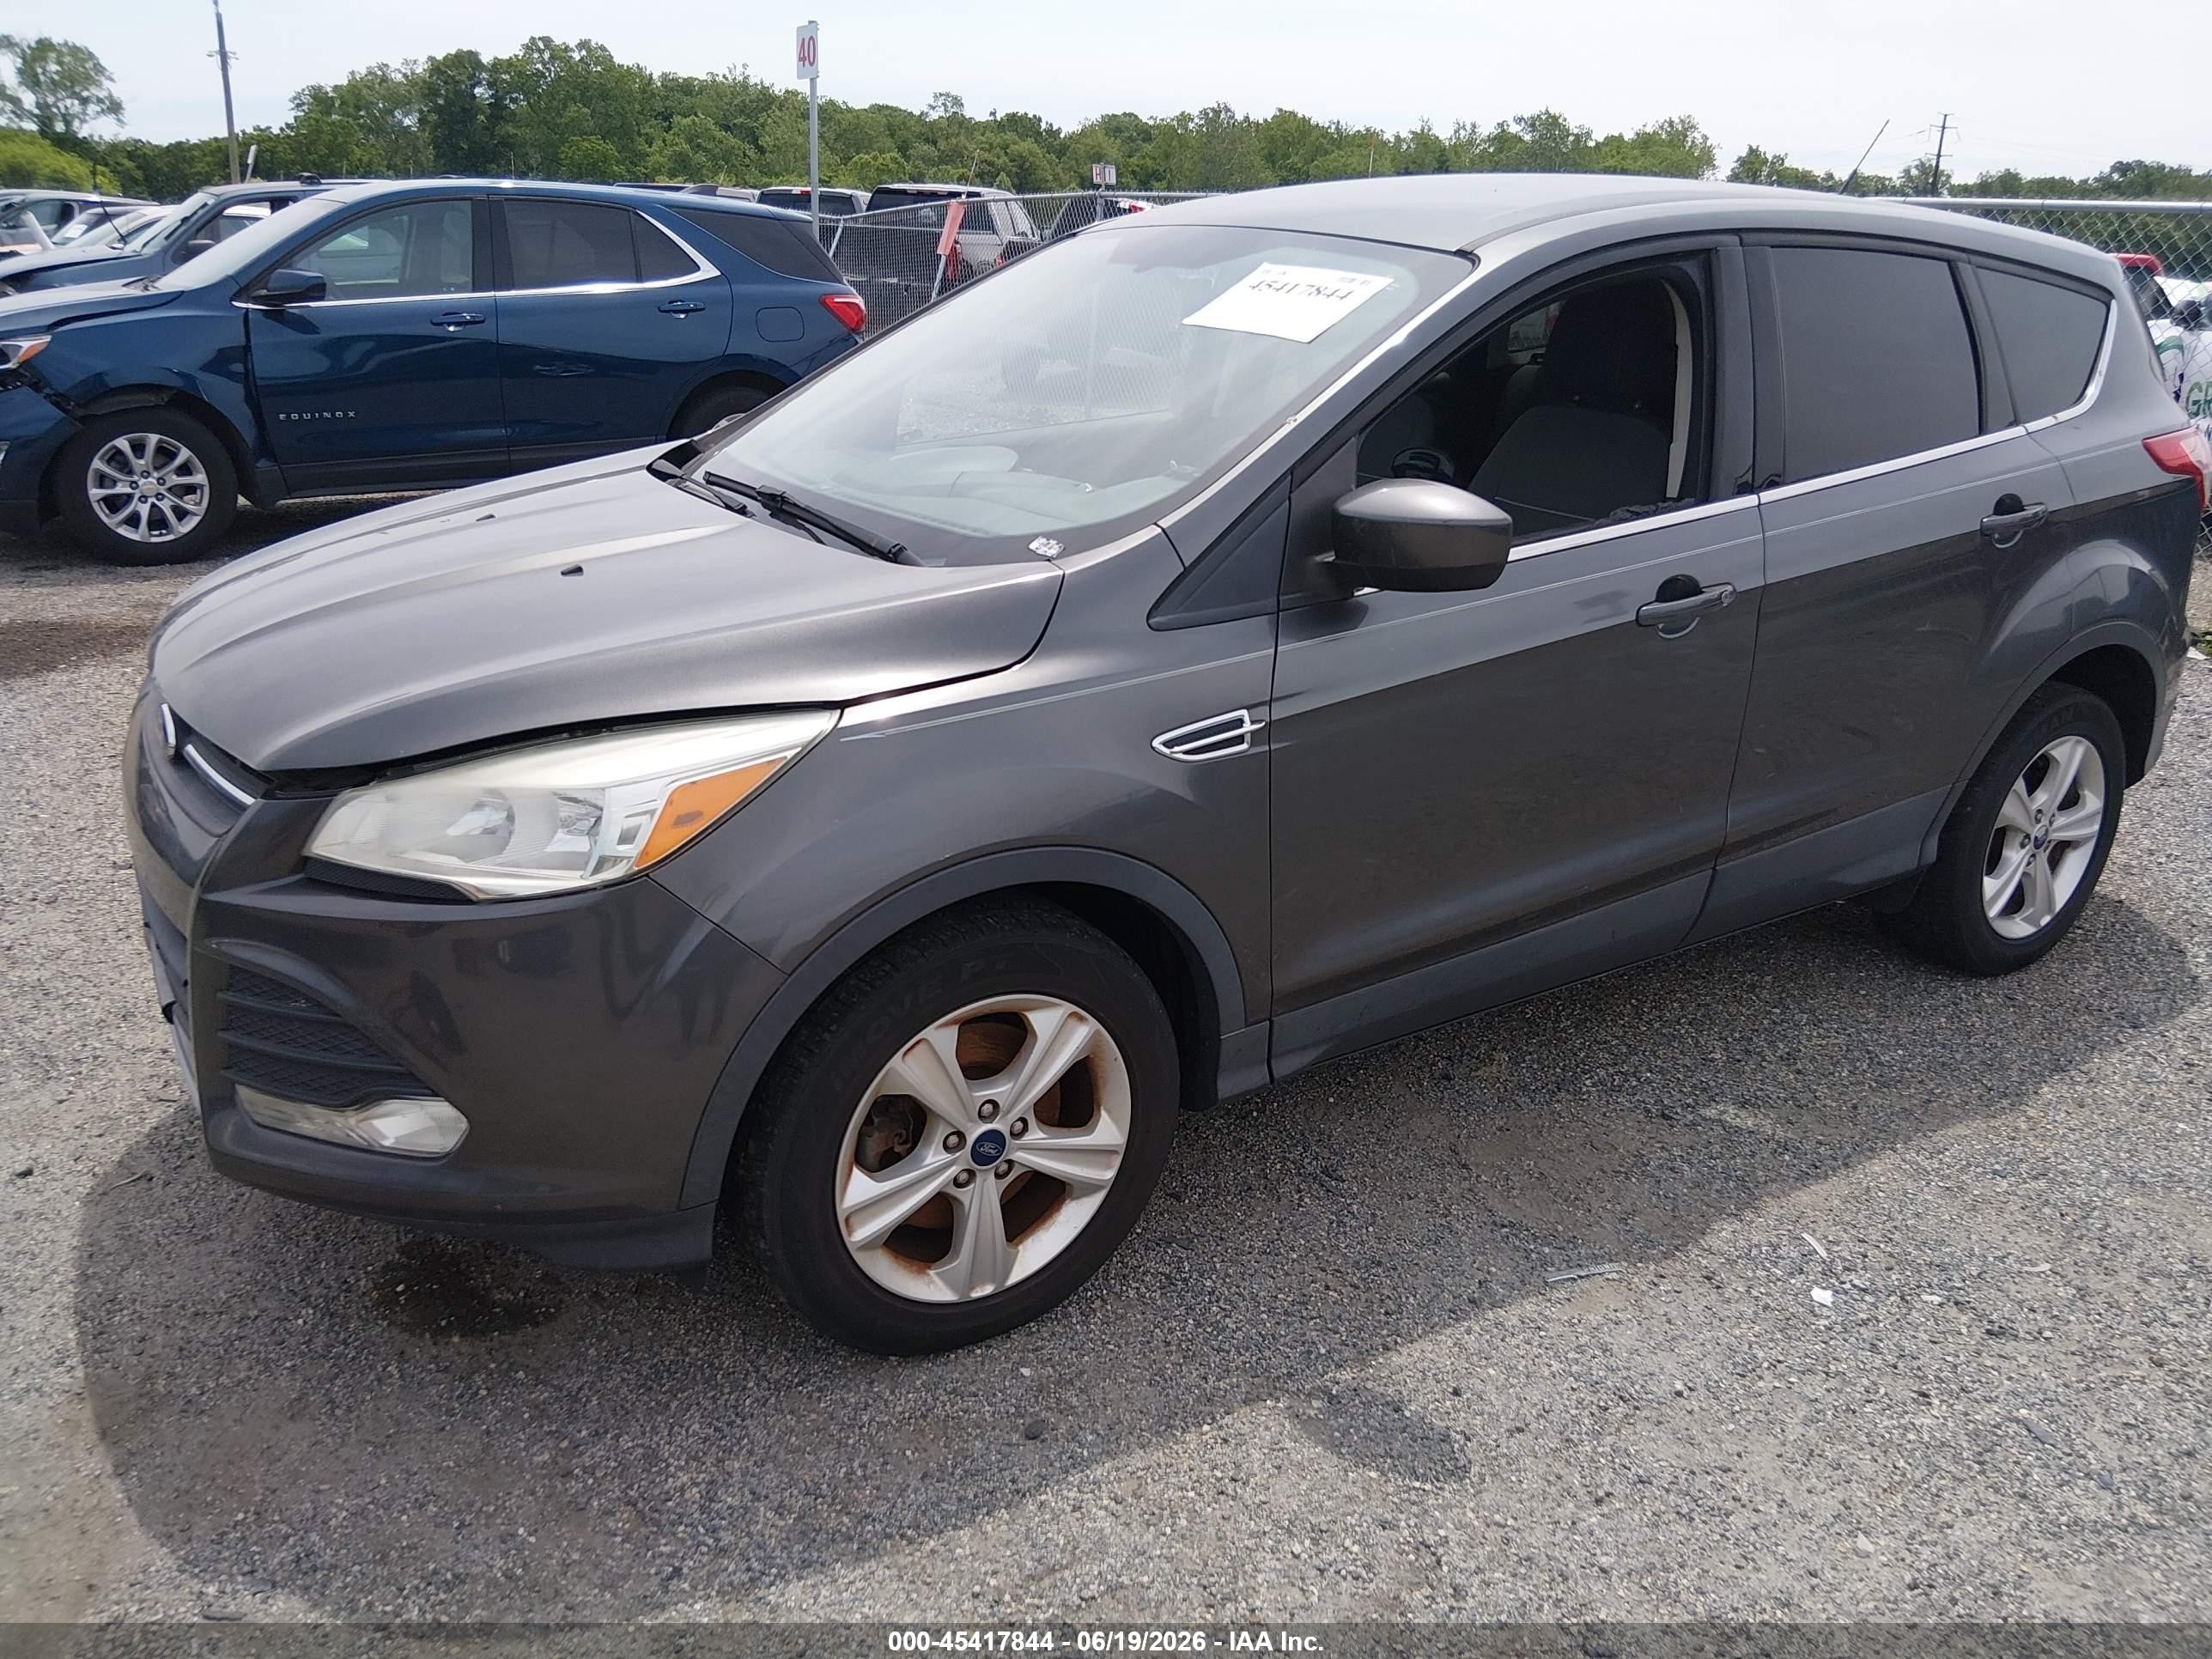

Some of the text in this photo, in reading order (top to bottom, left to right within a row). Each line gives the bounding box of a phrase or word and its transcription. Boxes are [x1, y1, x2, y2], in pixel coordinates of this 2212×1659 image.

[798, 35, 817, 68] 40
[1249, 279, 1354, 301] 45417844
[278, 411, 356, 421] EQUINOX
